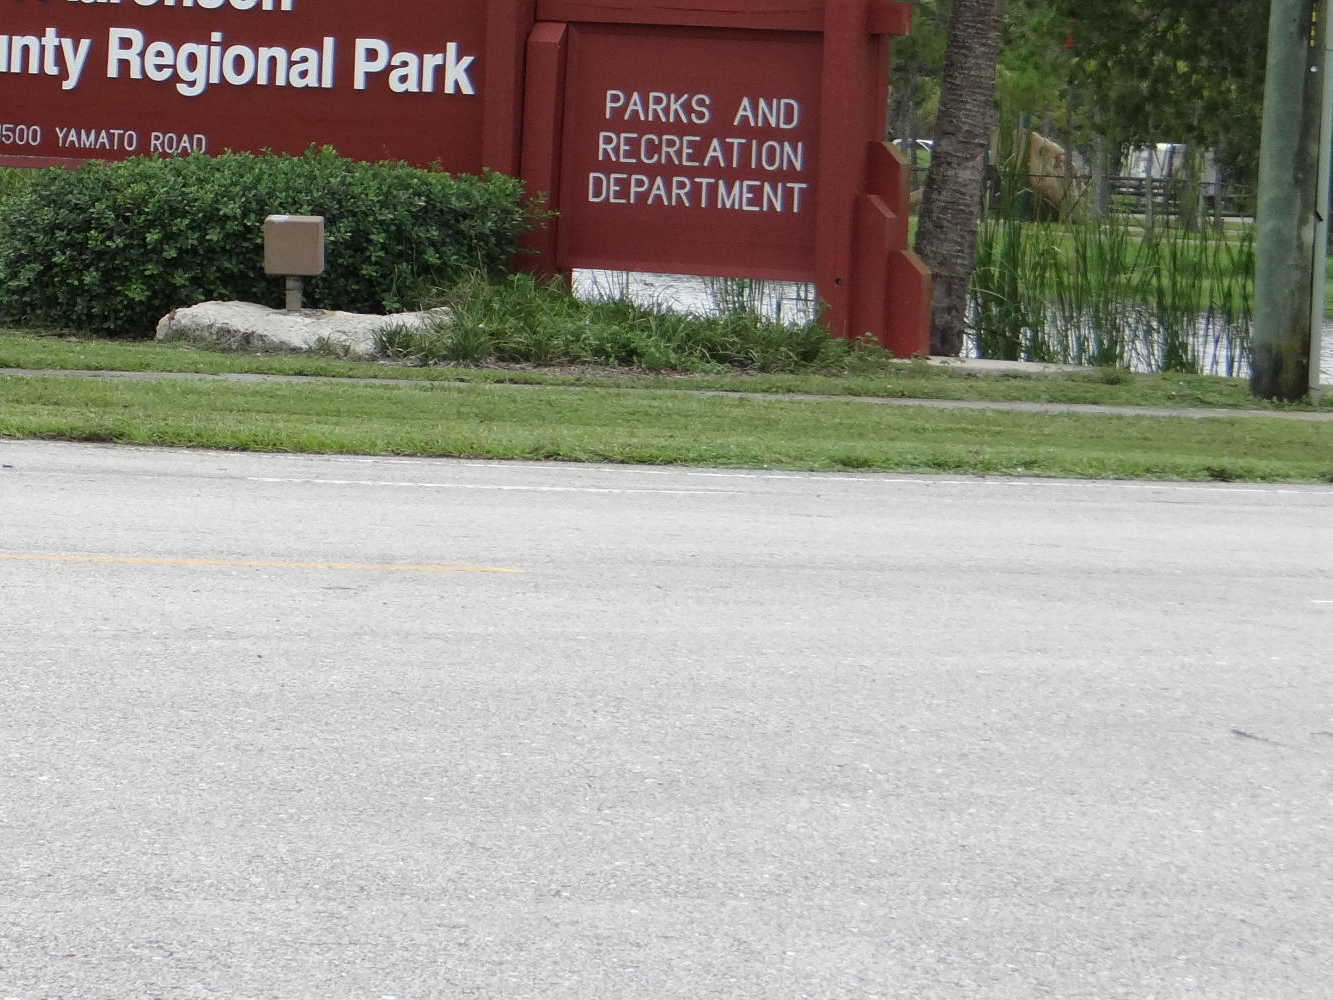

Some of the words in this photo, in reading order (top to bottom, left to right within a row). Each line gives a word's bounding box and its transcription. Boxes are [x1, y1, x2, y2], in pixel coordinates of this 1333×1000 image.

[106, 27, 336, 97] Regional
[353, 38, 476, 95] Park
[605, 89, 711, 125] PARKS
[733, 96, 799, 129] AND
[55, 127, 138, 151] YAMATO
[150, 131, 206, 154] ROAD
[598, 131, 803, 172] RECREATION
[588, 172, 807, 213] DEPARTMENT
